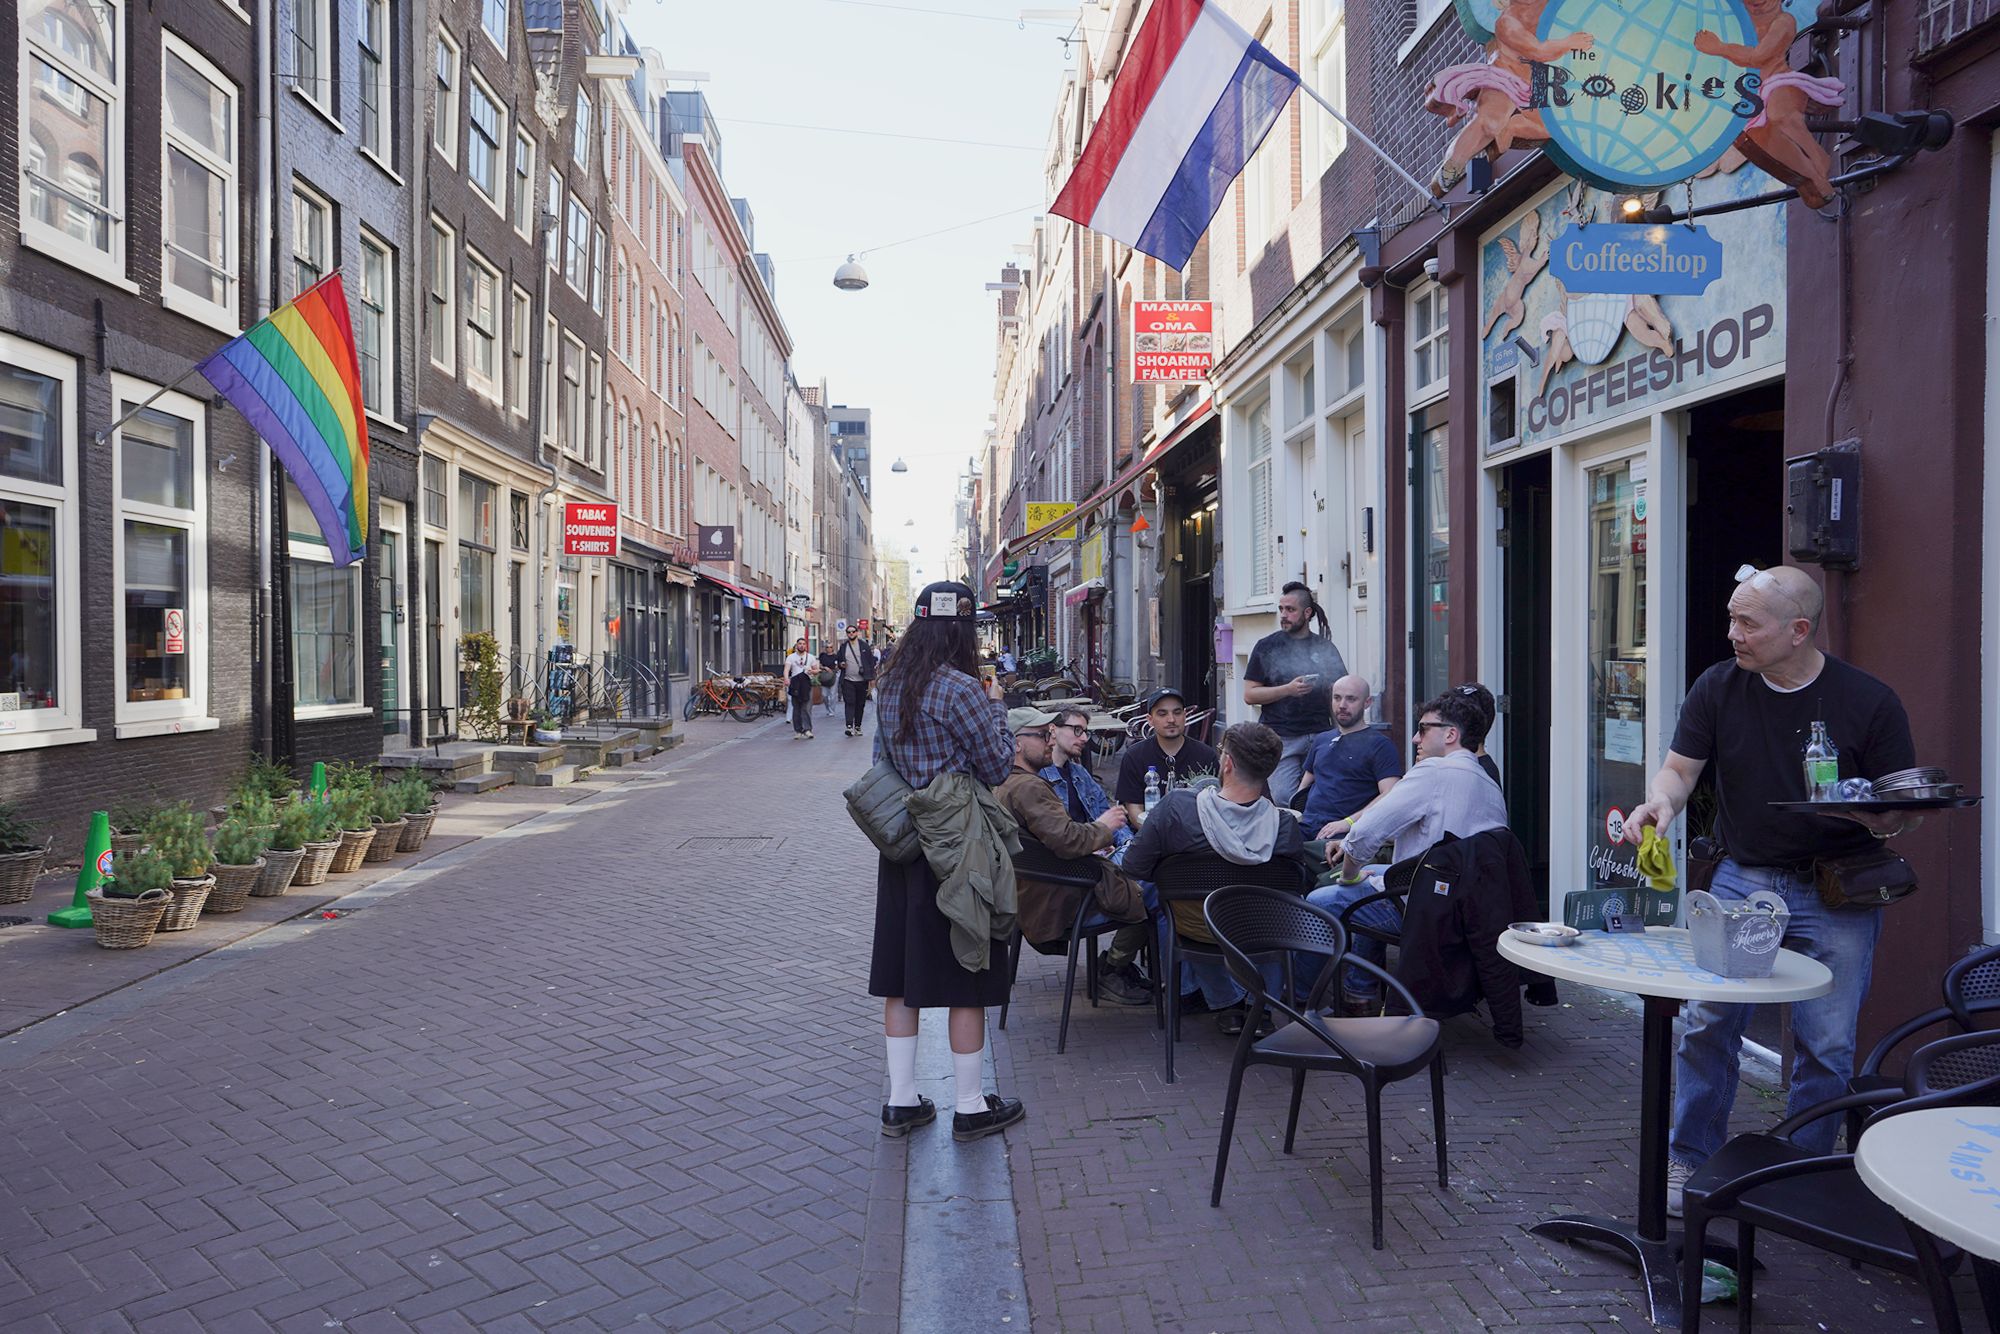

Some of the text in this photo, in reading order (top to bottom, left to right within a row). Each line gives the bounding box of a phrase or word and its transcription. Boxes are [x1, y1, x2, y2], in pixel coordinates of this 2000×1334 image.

[1570, 48, 1596, 61] The
[1565, 241, 1708, 279] Coffeeshop
[1141, 303, 1204, 312] MAMA
[1166, 312, 1180, 321] &
[1149, 322, 1197, 331] OMA
[1137, 355, 1211, 367] SHOARMA
[1142, 368, 1206, 380] FALAFEL
[1527, 303, 1774, 434] COFFEESHOP
[577, 508, 607, 521] TABAC
[566, 524, 616, 537] SOUVENIRS
[571, 540, 610, 553] T-SHIRTS
[1731, 927, 1777, 949] Flowers
